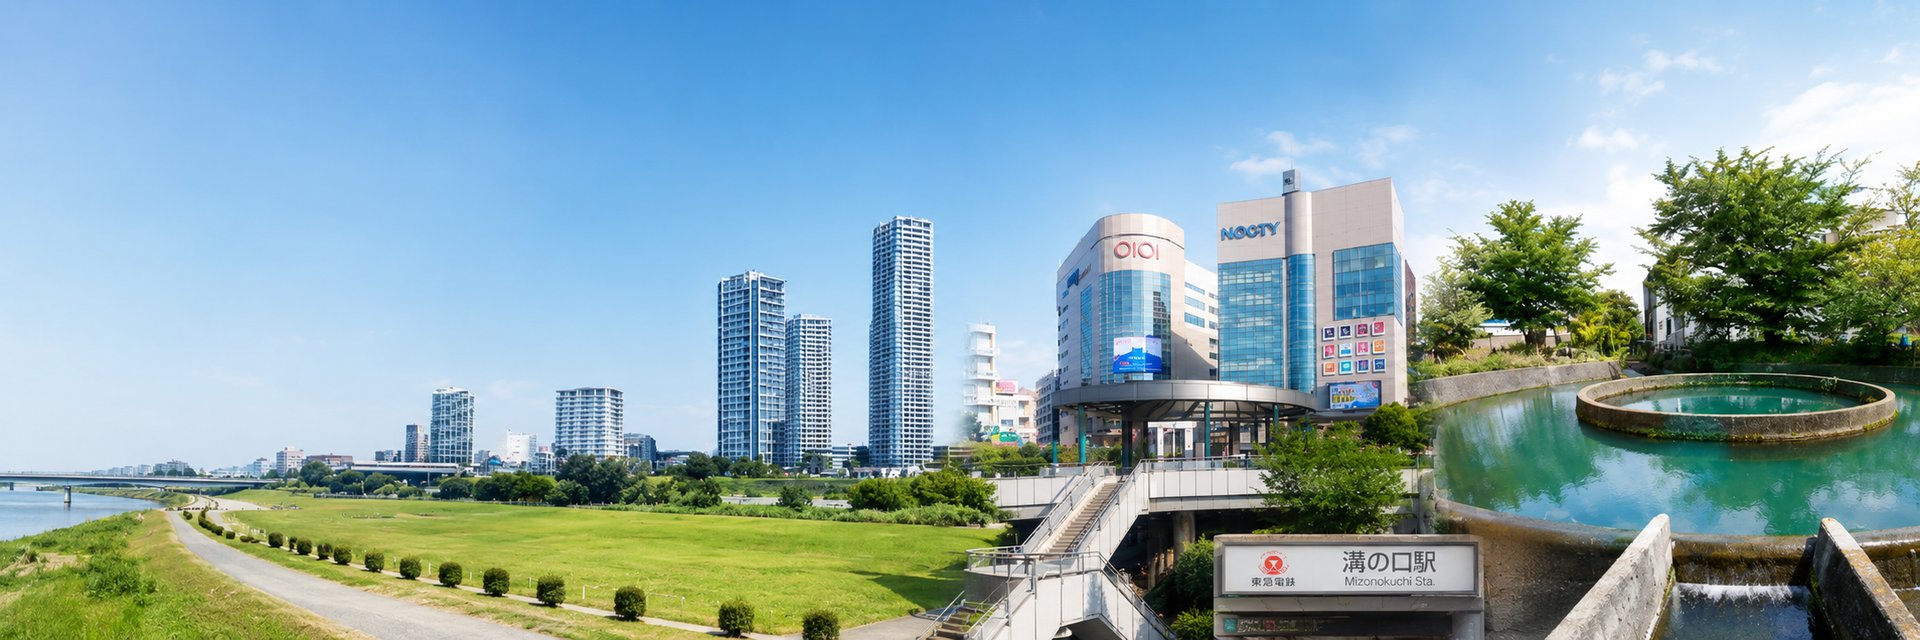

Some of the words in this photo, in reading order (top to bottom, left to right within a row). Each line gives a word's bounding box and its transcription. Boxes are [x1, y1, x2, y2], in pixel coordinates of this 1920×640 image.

[1220, 221, 1281, 241] NOCTY
[1342, 550, 1436, 573] 溝の口駅
[1344, 576, 1412, 587] Mizonokuchi
[1415, 576, 1436, 587] Sta.
